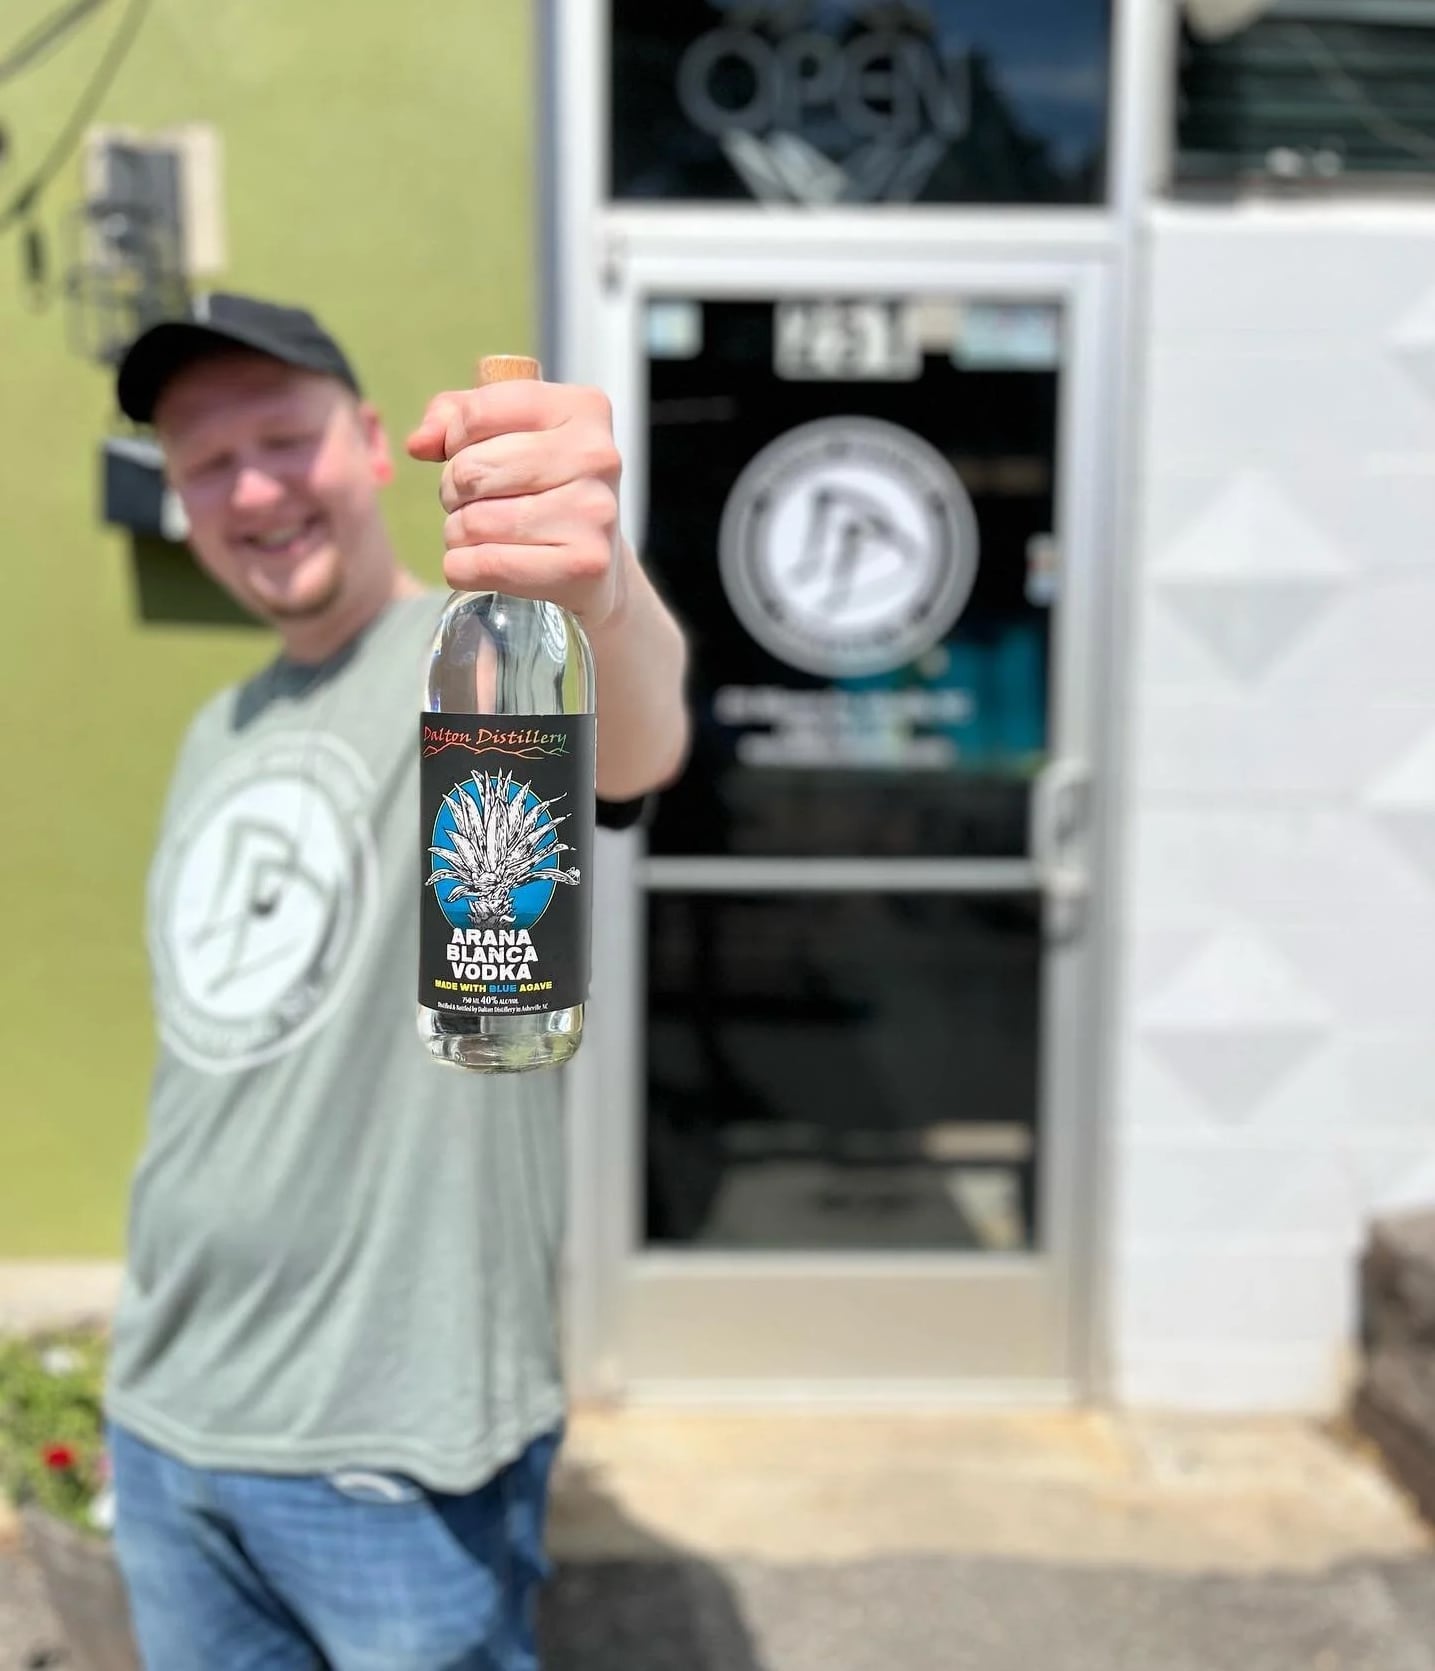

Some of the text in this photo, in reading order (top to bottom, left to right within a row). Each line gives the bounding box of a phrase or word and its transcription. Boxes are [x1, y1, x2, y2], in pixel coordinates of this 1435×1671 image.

[423, 726, 567, 751] Dalton Distillery
[446, 943, 539, 963] BLANCA
[452, 962, 532, 980] VODKA
[434, 979, 553, 993] MADE WITH BLUE AGAVE
[480, 995, 499, 1005] 40%
